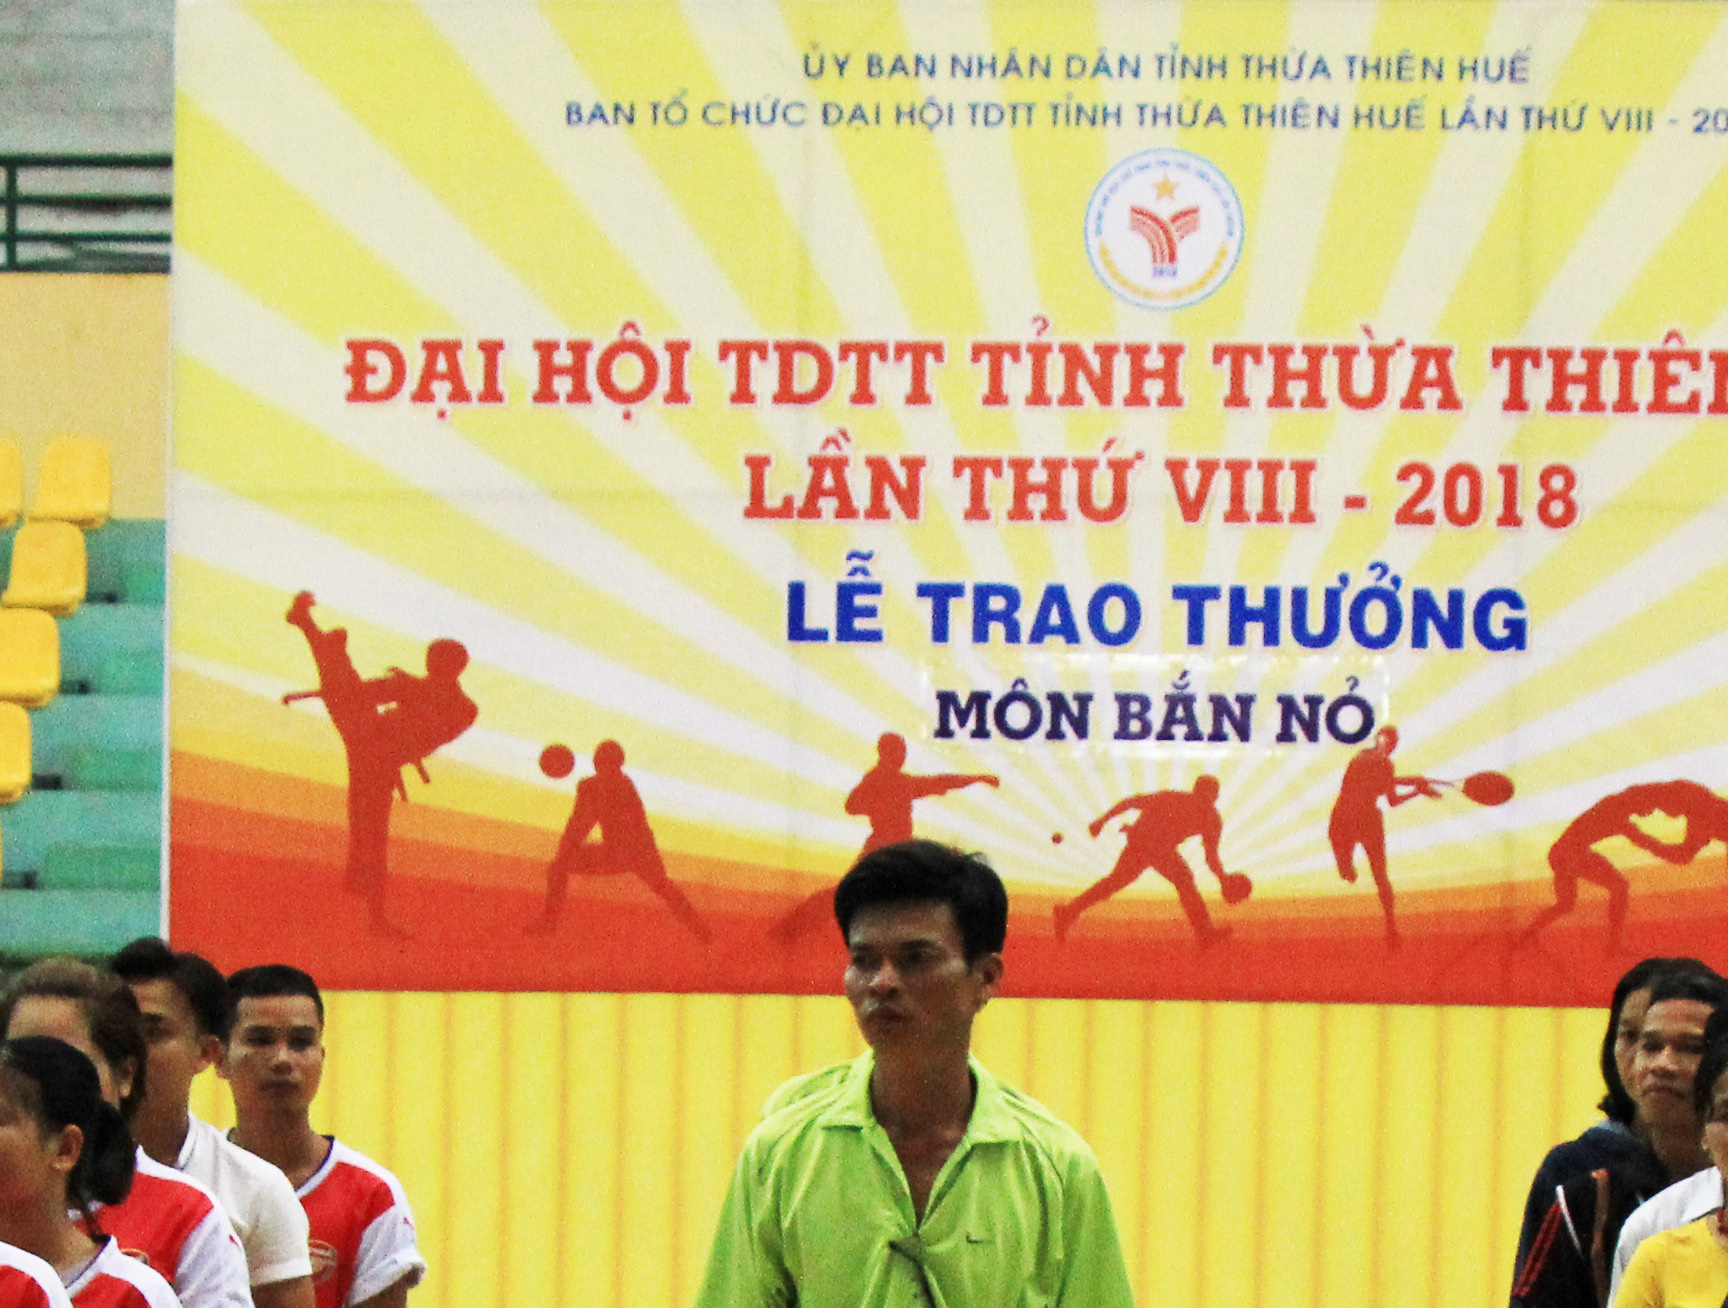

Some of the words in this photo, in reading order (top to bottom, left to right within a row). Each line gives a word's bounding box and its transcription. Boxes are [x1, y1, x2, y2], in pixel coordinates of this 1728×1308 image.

[802, 42, 851, 80] ỦY
[866, 52, 937, 79] BAN
[950, 48, 1052, 79] NHÂN
[1065, 48, 1141, 80] DÂN
[1155, 43, 1228, 80] TỈNH
[1345, 49, 1445, 82] THIÊN
[1458, 47, 1531, 84] HUẾ
[565, 101, 636, 127] BAN
[650, 89, 689, 126] TỔ
[701, 98, 806, 127] CHỨC
[821, 101, 881, 131] ĐẠI
[895, 96, 954, 131] HỘI
[968, 102, 1036, 127] TDTT
[1049, 93, 1122, 128] TỈNH
[1241, 98, 1340, 129] THIÊN
[1600, 108, 1654, 132] VIII
[345, 340, 505, 419] ĐẠI
[533, 322, 691, 421] HỘI
[719, 341, 944, 406] TDTT
[971, 319, 1184, 407] TỈNH
[1213, 325, 1462, 411] THỪA
[744, 431, 926, 520] LẦN
[953, 439, 1144, 523] THỨ
[1165, 459, 1316, 524] VIII
[1395, 462, 1577, 530] 2018
[788, 551, 883, 642] LỄ
[917, 583, 1141, 646] TRAO
[1172, 562, 1527, 651] THƯỞNG
[935, 678, 1093, 740] MÔN
[1114, 670, 1255, 742] BẮN
[1276, 677, 1375, 744] NỎ
